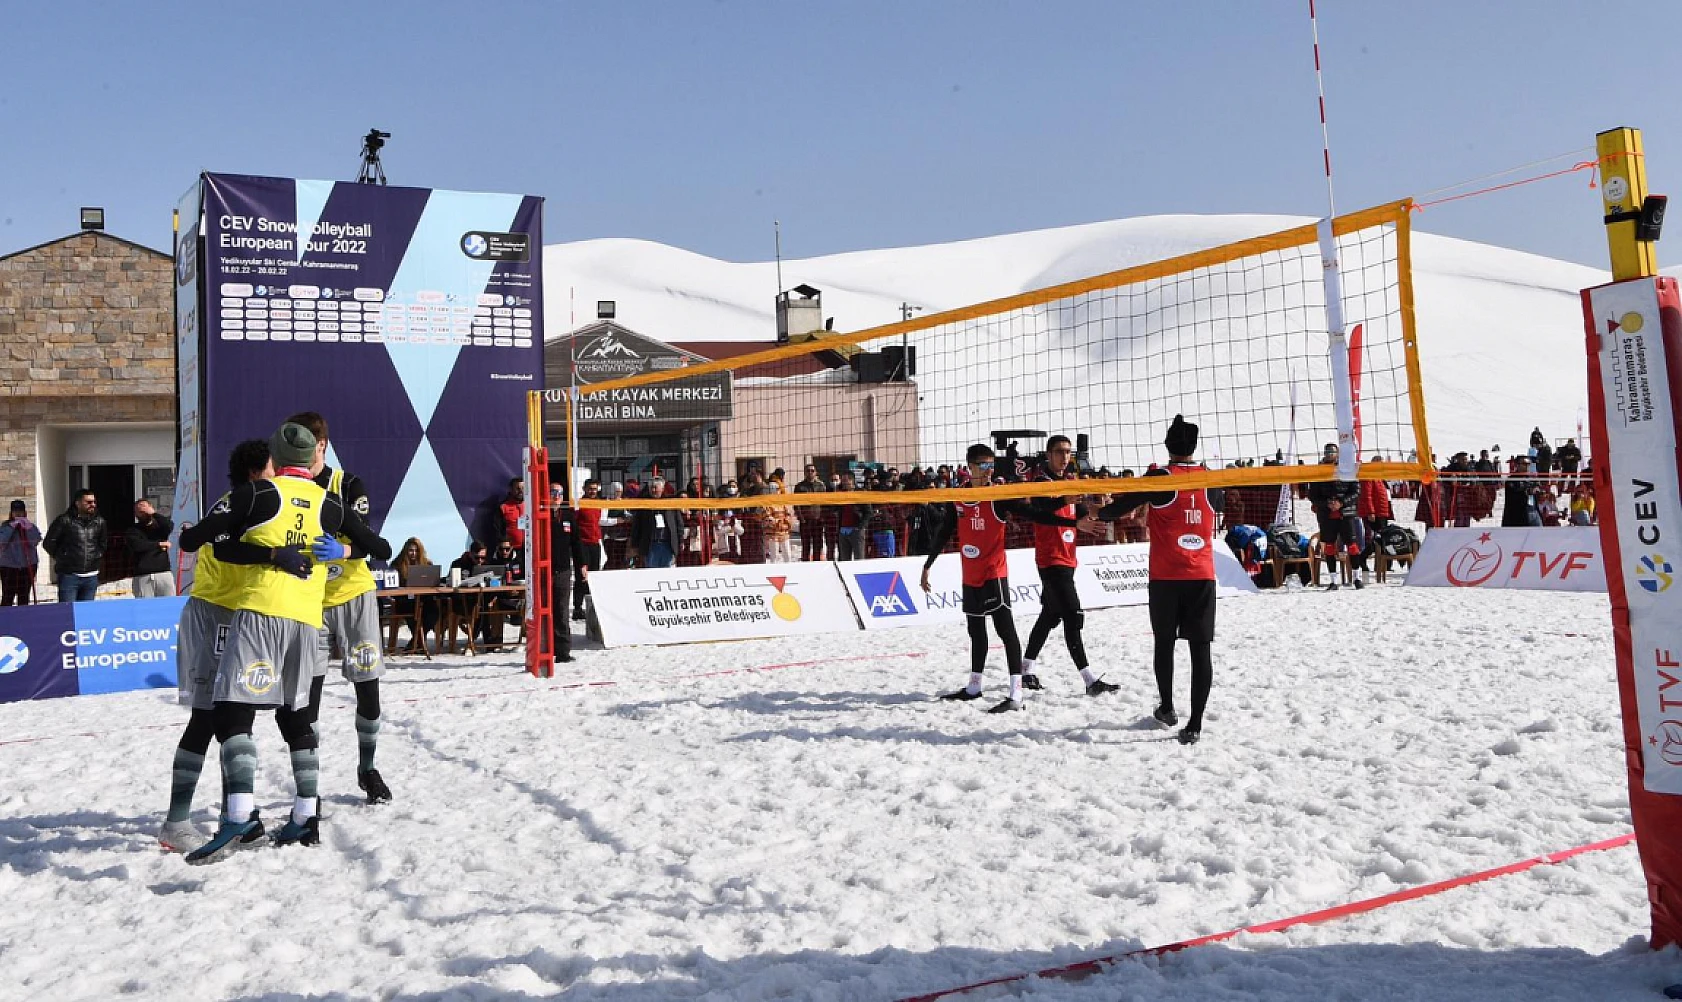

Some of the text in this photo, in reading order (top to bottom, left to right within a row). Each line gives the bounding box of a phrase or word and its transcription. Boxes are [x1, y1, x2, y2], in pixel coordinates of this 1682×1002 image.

[220, 215, 371, 239] CEV Snow Volleyball
[220, 233, 293, 252] European
[332, 240, 366, 254] 2022
[264, 258, 276, 266] Ski
[612, 388, 659, 401] KAYAK
[662, 384, 722, 400] MERKEZİ
[580, 403, 656, 419] İDARİ BİNA
[1190, 494, 1195, 509] 1
[974, 506, 980, 518] 3
[1184, 509, 1202, 524] TUR
[1632, 478, 1660, 545] CEV
[294, 513, 303, 531] 3
[970, 517, 985, 531] TUR
[286, 530, 308, 547] RUS
[1511, 552, 1593, 580] TVF
[644, 593, 765, 612] Kahramanmaraş
[871, 594, 909, 613] AXA
[926, 590, 963, 610] AXA
[649, 607, 771, 628] Büyükşehir Belediyesi
[60, 627, 171, 647] CEV Snow
[62, 649, 167, 669] European
[1656, 648, 1682, 713] TVF
